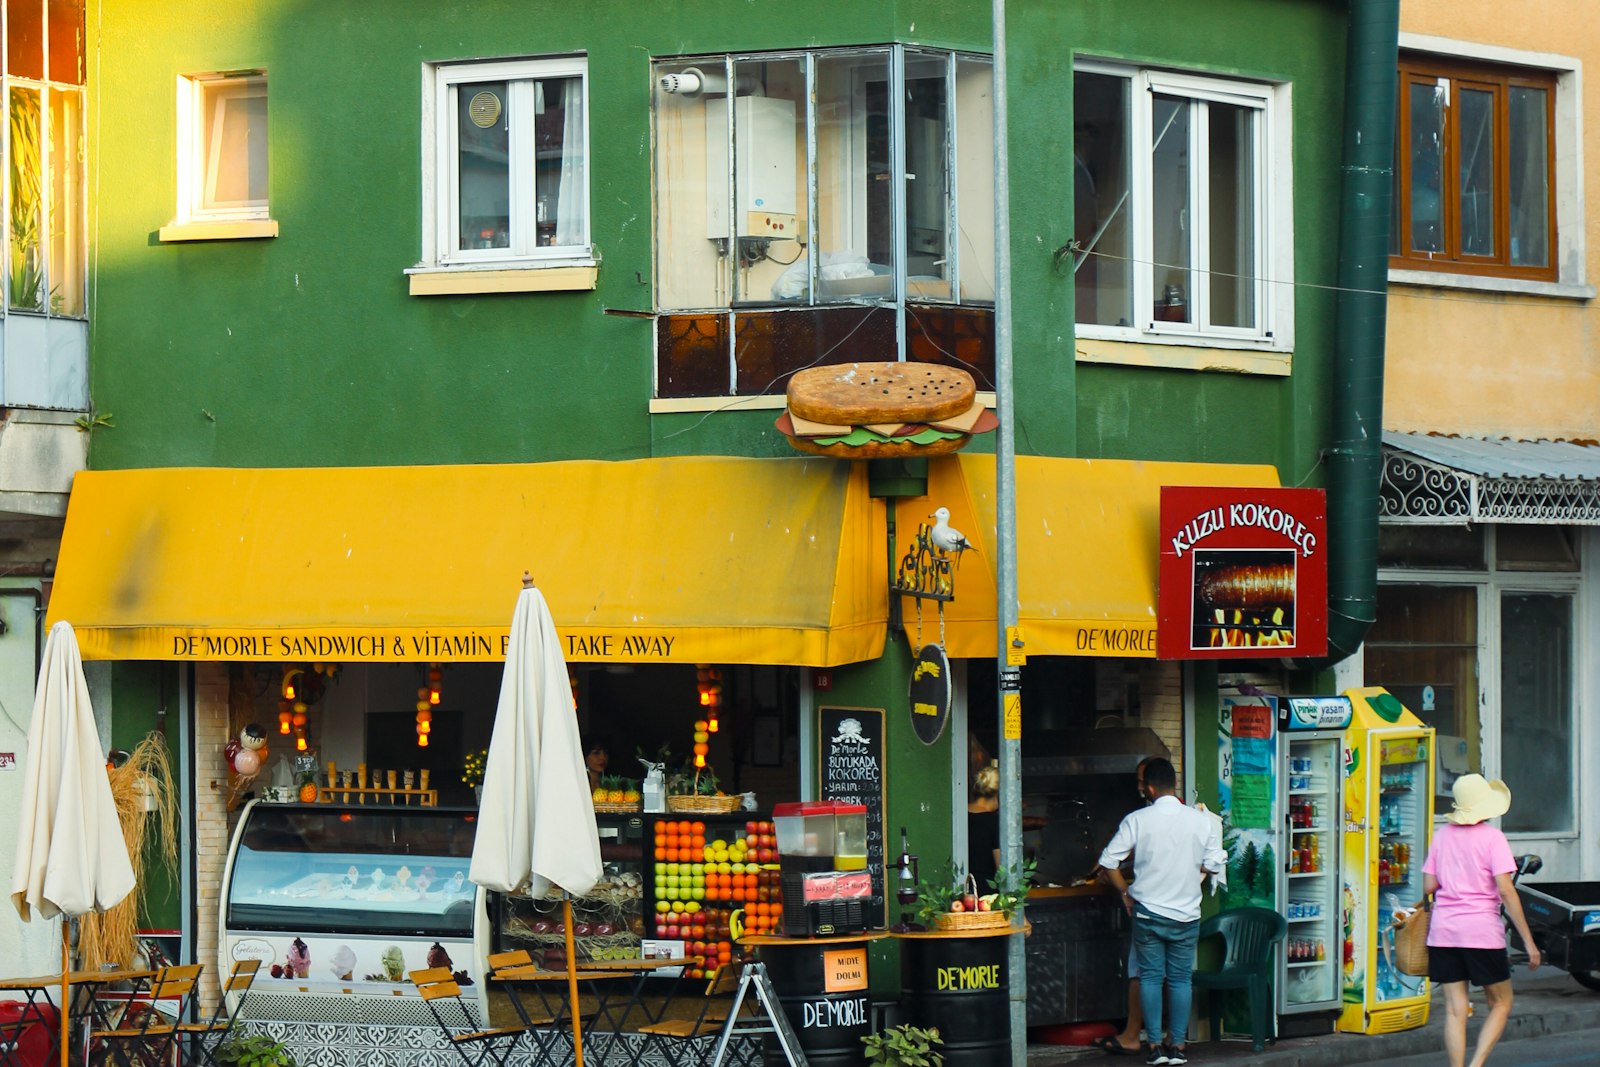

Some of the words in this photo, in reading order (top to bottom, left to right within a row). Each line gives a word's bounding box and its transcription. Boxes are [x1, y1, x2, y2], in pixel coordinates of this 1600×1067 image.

[1172, 507, 1224, 557] KUZU
[1230, 503, 1316, 557] KOKOREÇ
[174, 636, 273, 656] DE'MORLE
[280, 636, 384, 657] SANDWICH
[392, 636, 405, 656] &
[566, 635, 613, 656] TAKE
[621, 636, 675, 656] AWAY
[1077, 628, 1157, 650] DE'MORLE
[817, 676, 828, 687] 18
[828, 753, 878, 769] BÜYÜKADA
[829, 766, 879, 783] KOKOREÇ
[836, 970, 861, 981] DOLMA
